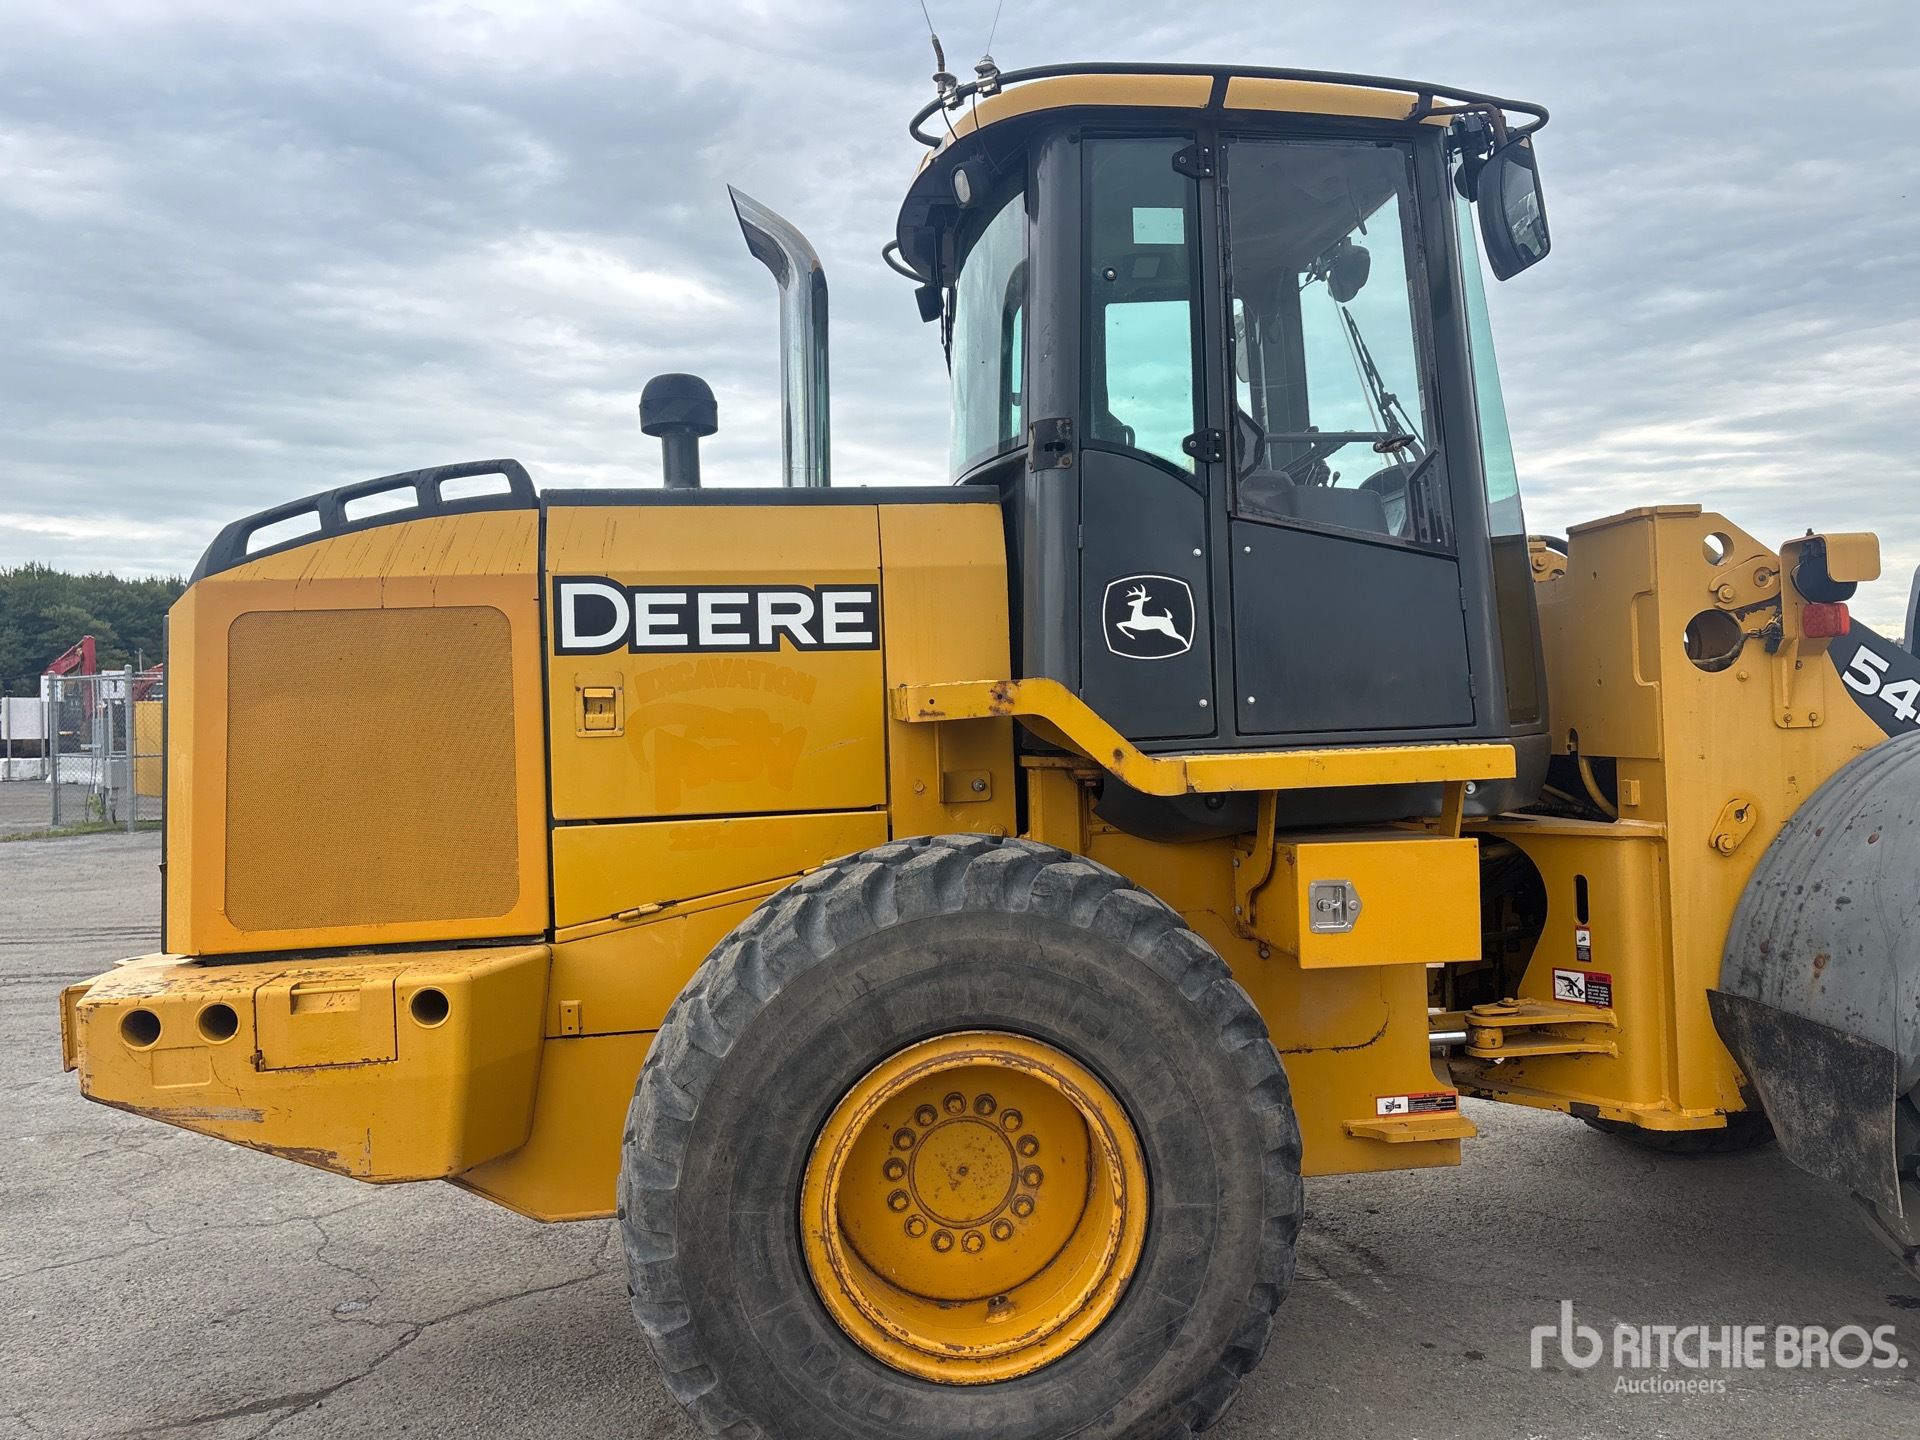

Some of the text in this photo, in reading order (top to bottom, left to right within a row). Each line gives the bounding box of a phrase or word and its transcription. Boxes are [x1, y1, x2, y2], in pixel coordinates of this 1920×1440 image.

[560, 582, 873, 648] DEERE
[634, 658, 817, 705] EXCAVATION
[1841, 645, 1920, 725] 54
